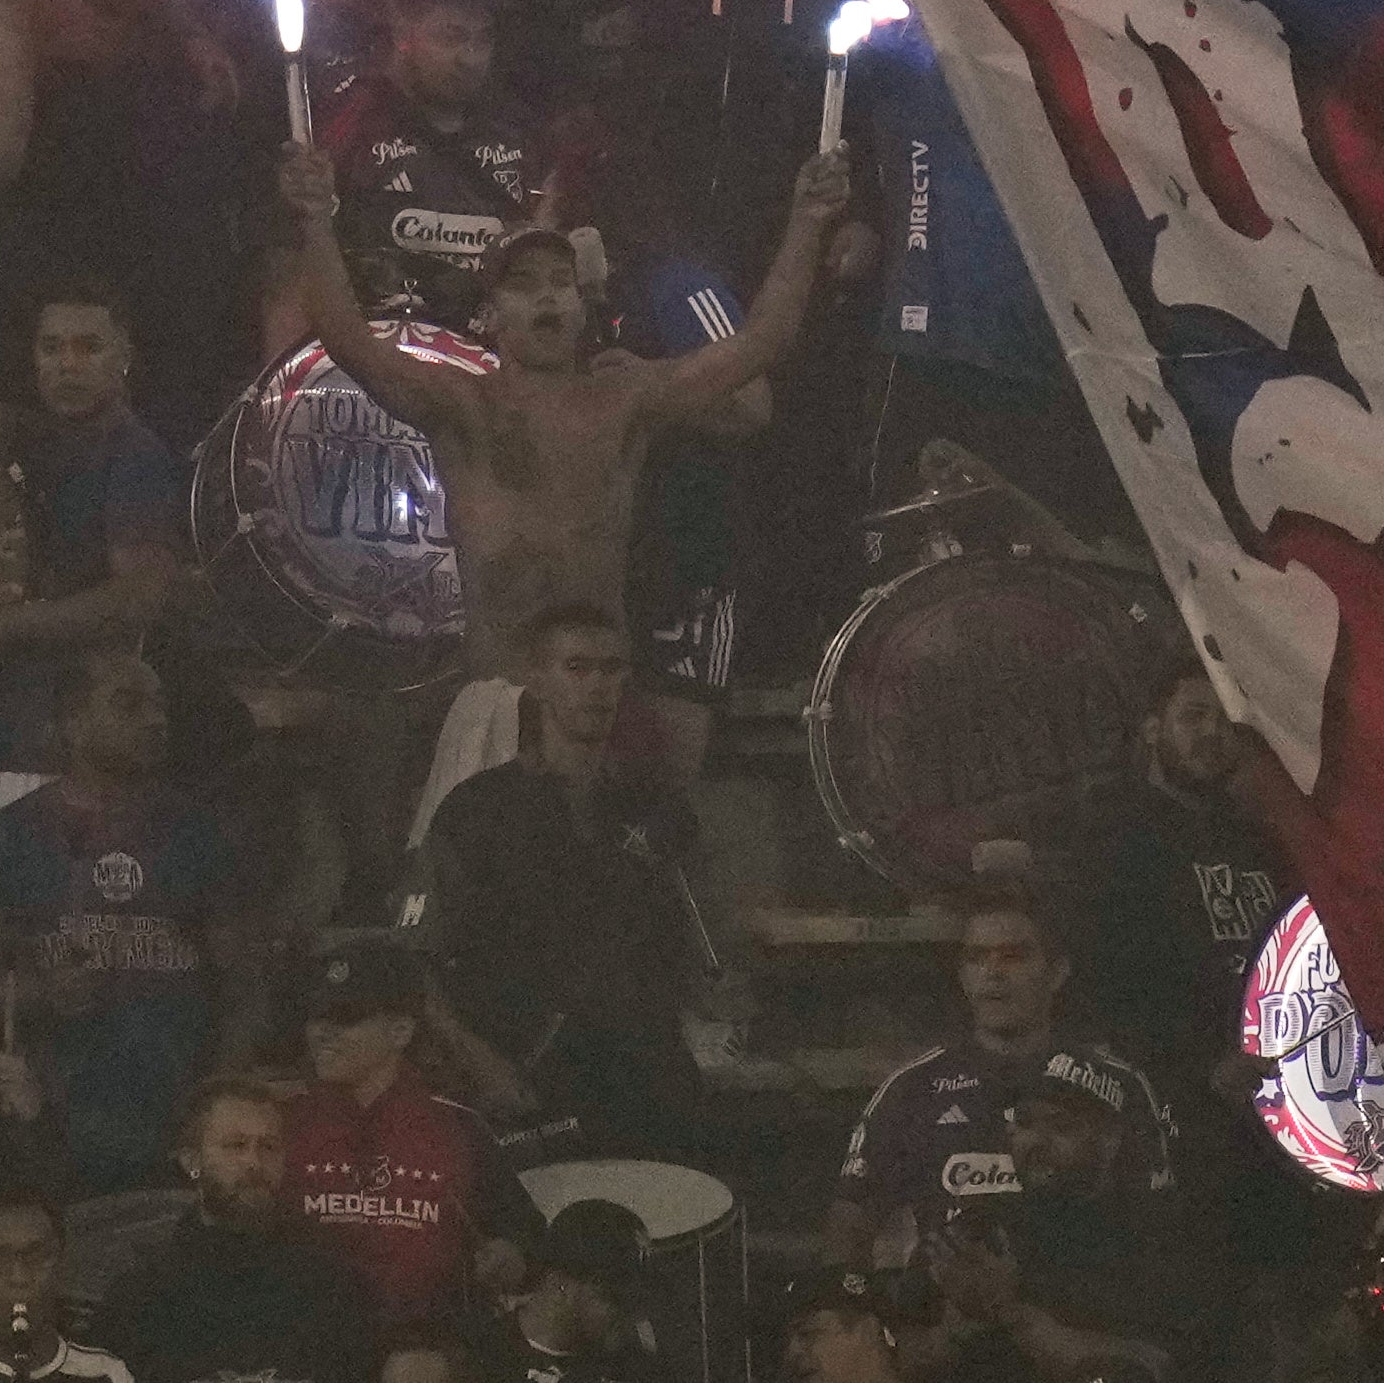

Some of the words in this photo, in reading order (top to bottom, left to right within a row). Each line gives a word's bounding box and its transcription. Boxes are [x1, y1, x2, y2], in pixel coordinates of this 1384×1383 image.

[474, 143, 523, 169] Pilsen
[907, 138, 929, 252] DIRECTV
[947, 1161, 1018, 1189] Cola
[303, 1192, 440, 1225] MEDELLIN
